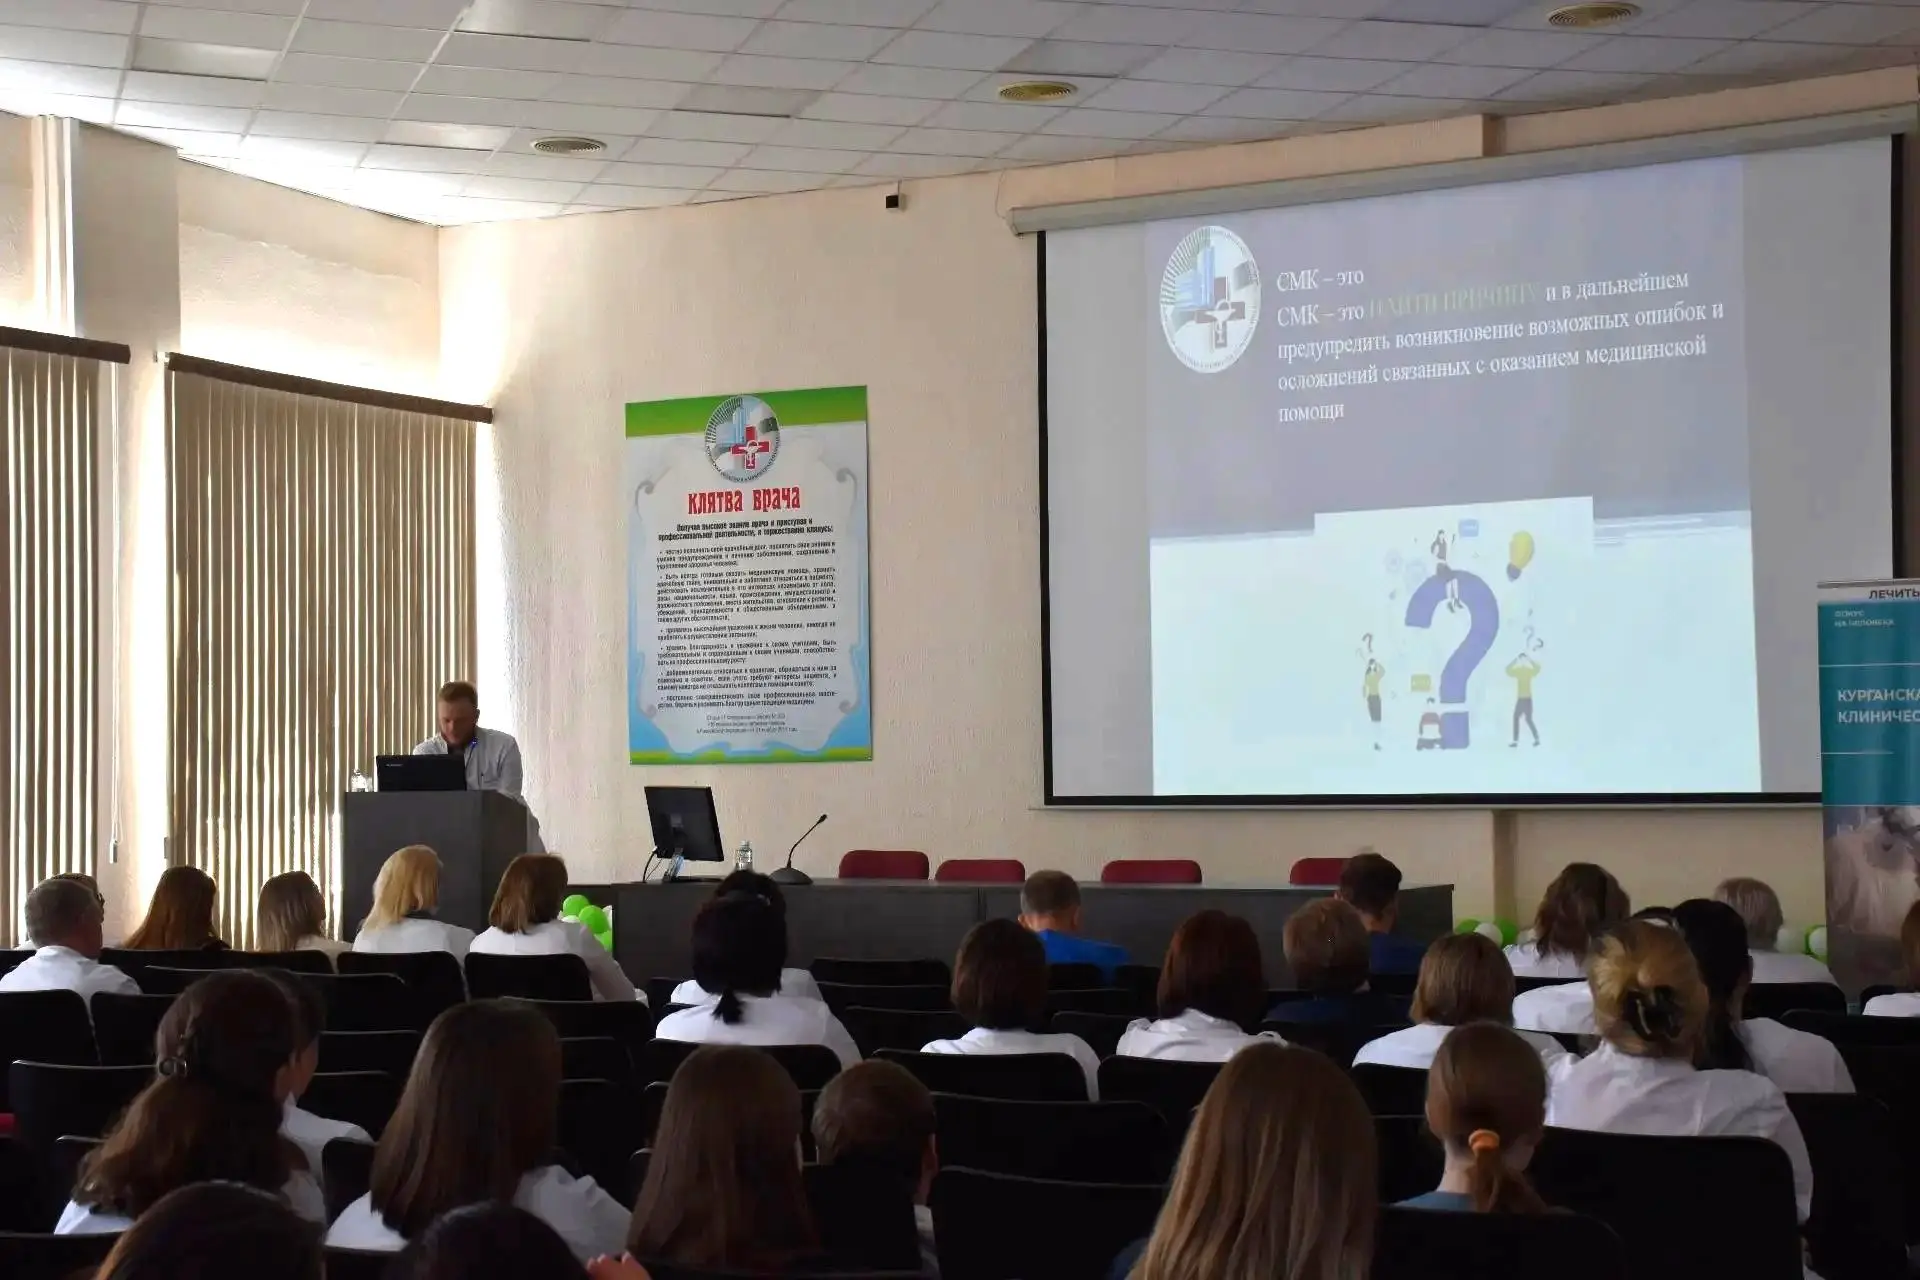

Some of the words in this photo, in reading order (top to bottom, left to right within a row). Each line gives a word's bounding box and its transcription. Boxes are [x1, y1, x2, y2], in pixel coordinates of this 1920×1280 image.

[1277, 269, 1319, 292] СМК
[1337, 269, 1365, 286] это
[1277, 304, 1319, 327] СМК
[1337, 304, 1365, 321] это
[1546, 286, 1556, 302] и
[1562, 284, 1571, 300] в
[1576, 271, 1689, 300] дальнейшем
[1278, 333, 1390, 365] предупредить
[1396, 319, 1524, 349] возникновение
[1529, 310, 1629, 337] возможных
[1634, 300, 1706, 327] ошибок
[1711, 301, 1724, 319] и
[1278, 364, 1378, 391] осложнений
[1383, 359, 1472, 383] связанных
[1476, 359, 1486, 374] с
[1490, 349, 1579, 374] оказанием
[1586, 334, 1707, 365] медицинской
[1278, 402, 1345, 423] помощи
[1869, 588, 1920, 599] ЛЕЧИТЬ
